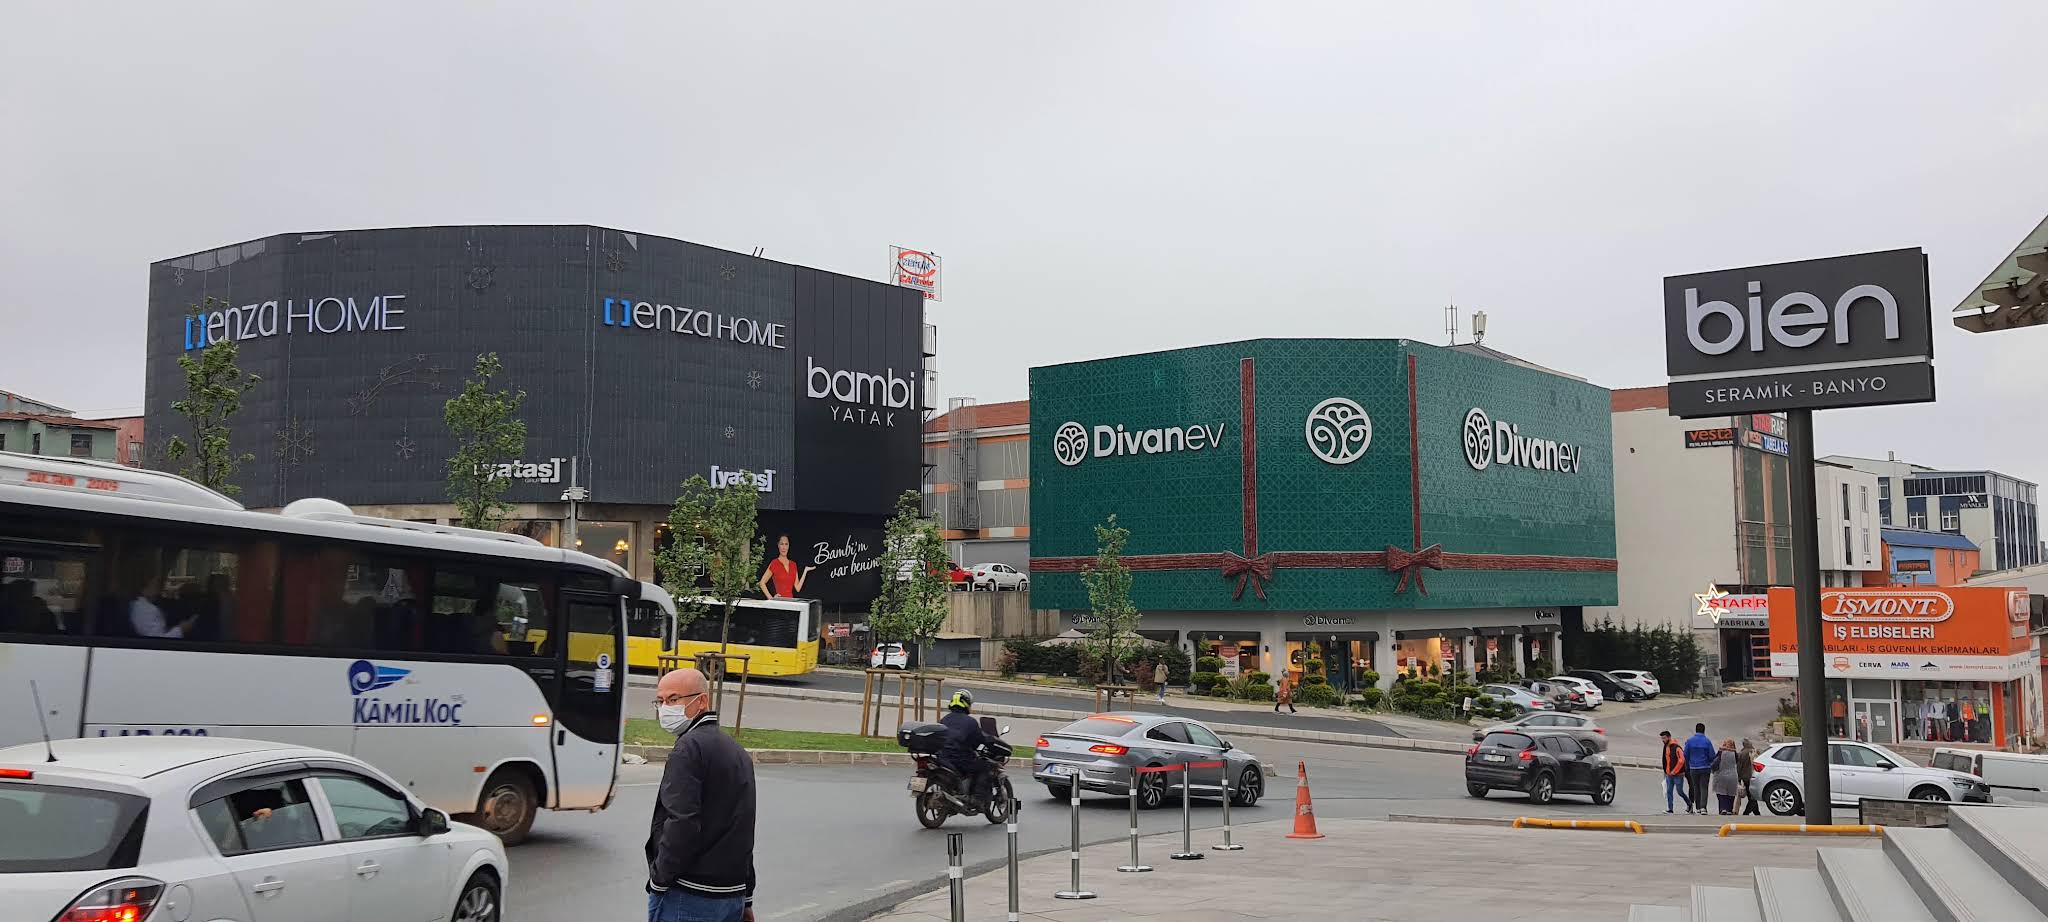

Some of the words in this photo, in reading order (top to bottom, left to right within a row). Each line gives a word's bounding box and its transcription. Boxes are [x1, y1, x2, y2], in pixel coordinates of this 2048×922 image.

[287, 295, 406, 334] HOME
[632, 301, 712, 338] enza
[717, 313, 786, 349] HOME
[1685, 280, 1899, 355] bien
[807, 356, 915, 410] bambi
[1705, 381, 1793, 403] SERAMİK
[1813, 376, 1887, 396] BANYO
[830, 405, 895, 428] YATAK
[1094, 422, 1225, 458] Divanev
[1495, 421, 1581, 475] Divanev
[1689, 428, 1733, 441] vesta
[830, 564, 848, 579] var
[1832, 593, 1938, 620] İŞMONT
[1834, 624, 1847, 640] İŞ
[1851, 624, 1935, 639] ELBİSELERİ
[600, 655, 608, 666] 8
[1878, 643, 1928, 653] GÜVENLİK
[1931, 644, 2000, 655] EKİPMANLARI
